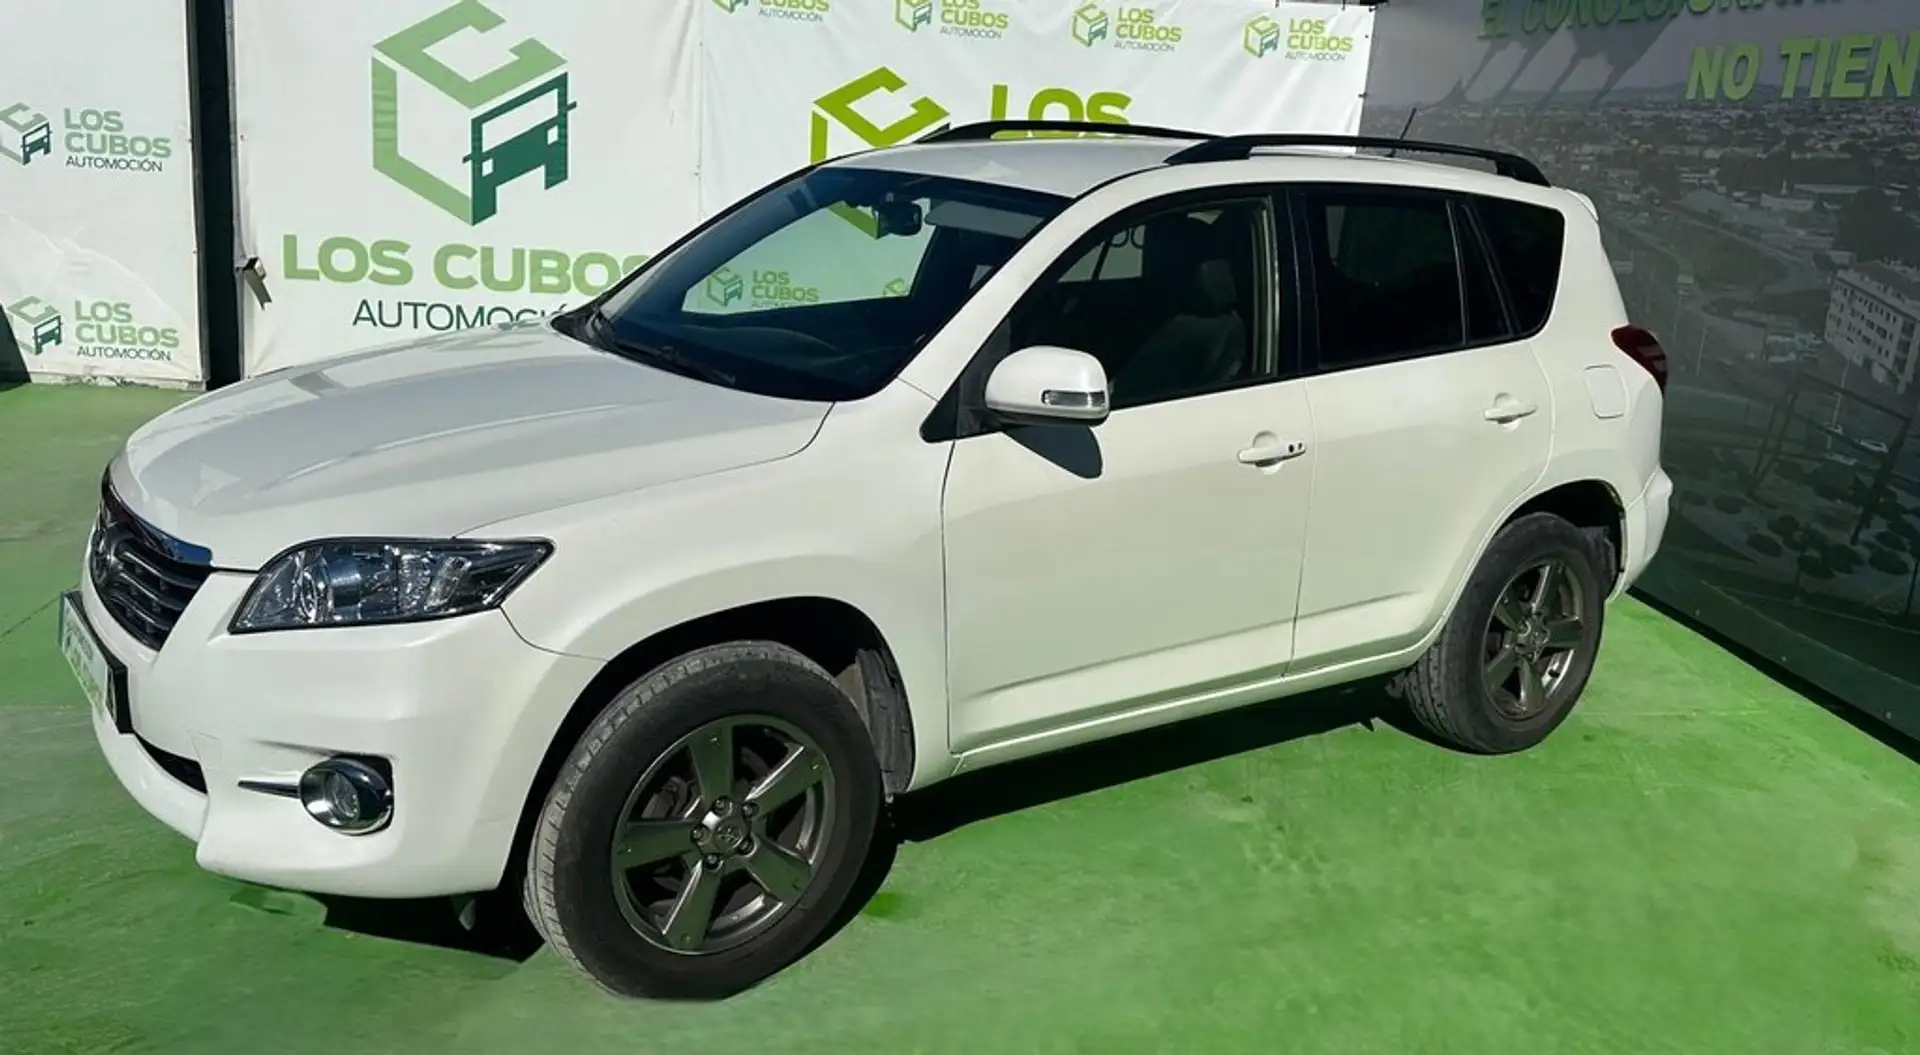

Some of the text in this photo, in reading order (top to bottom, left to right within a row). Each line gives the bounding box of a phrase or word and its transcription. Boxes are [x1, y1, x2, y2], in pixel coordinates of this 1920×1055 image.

[940, 9, 1010, 30] CUBOS
[1117, 6, 1155, 24] LOS
[1115, 24, 1183, 43] CUBOS
[1288, 17, 1326, 35] LOS
[1286, 34, 1354, 53] CUBOS
[1685, 29, 1920, 102] NO TIEN
[64, 107, 124, 133] LOS
[990, 84, 1132, 141] LOS
[64, 131, 173, 159] CUBOS
[65, 155, 163, 172] AUTOMOCIÓN
[282, 233, 414, 286] LOS
[753, 269, 791, 286] LOS
[751, 284, 821, 303] CUBOS
[74, 299, 133, 324] LOS
[351, 299, 568, 332] AUTOMO
[75, 323, 180, 349] CUBOS
[76, 346, 172, 361] AUTOMOCIÓN
